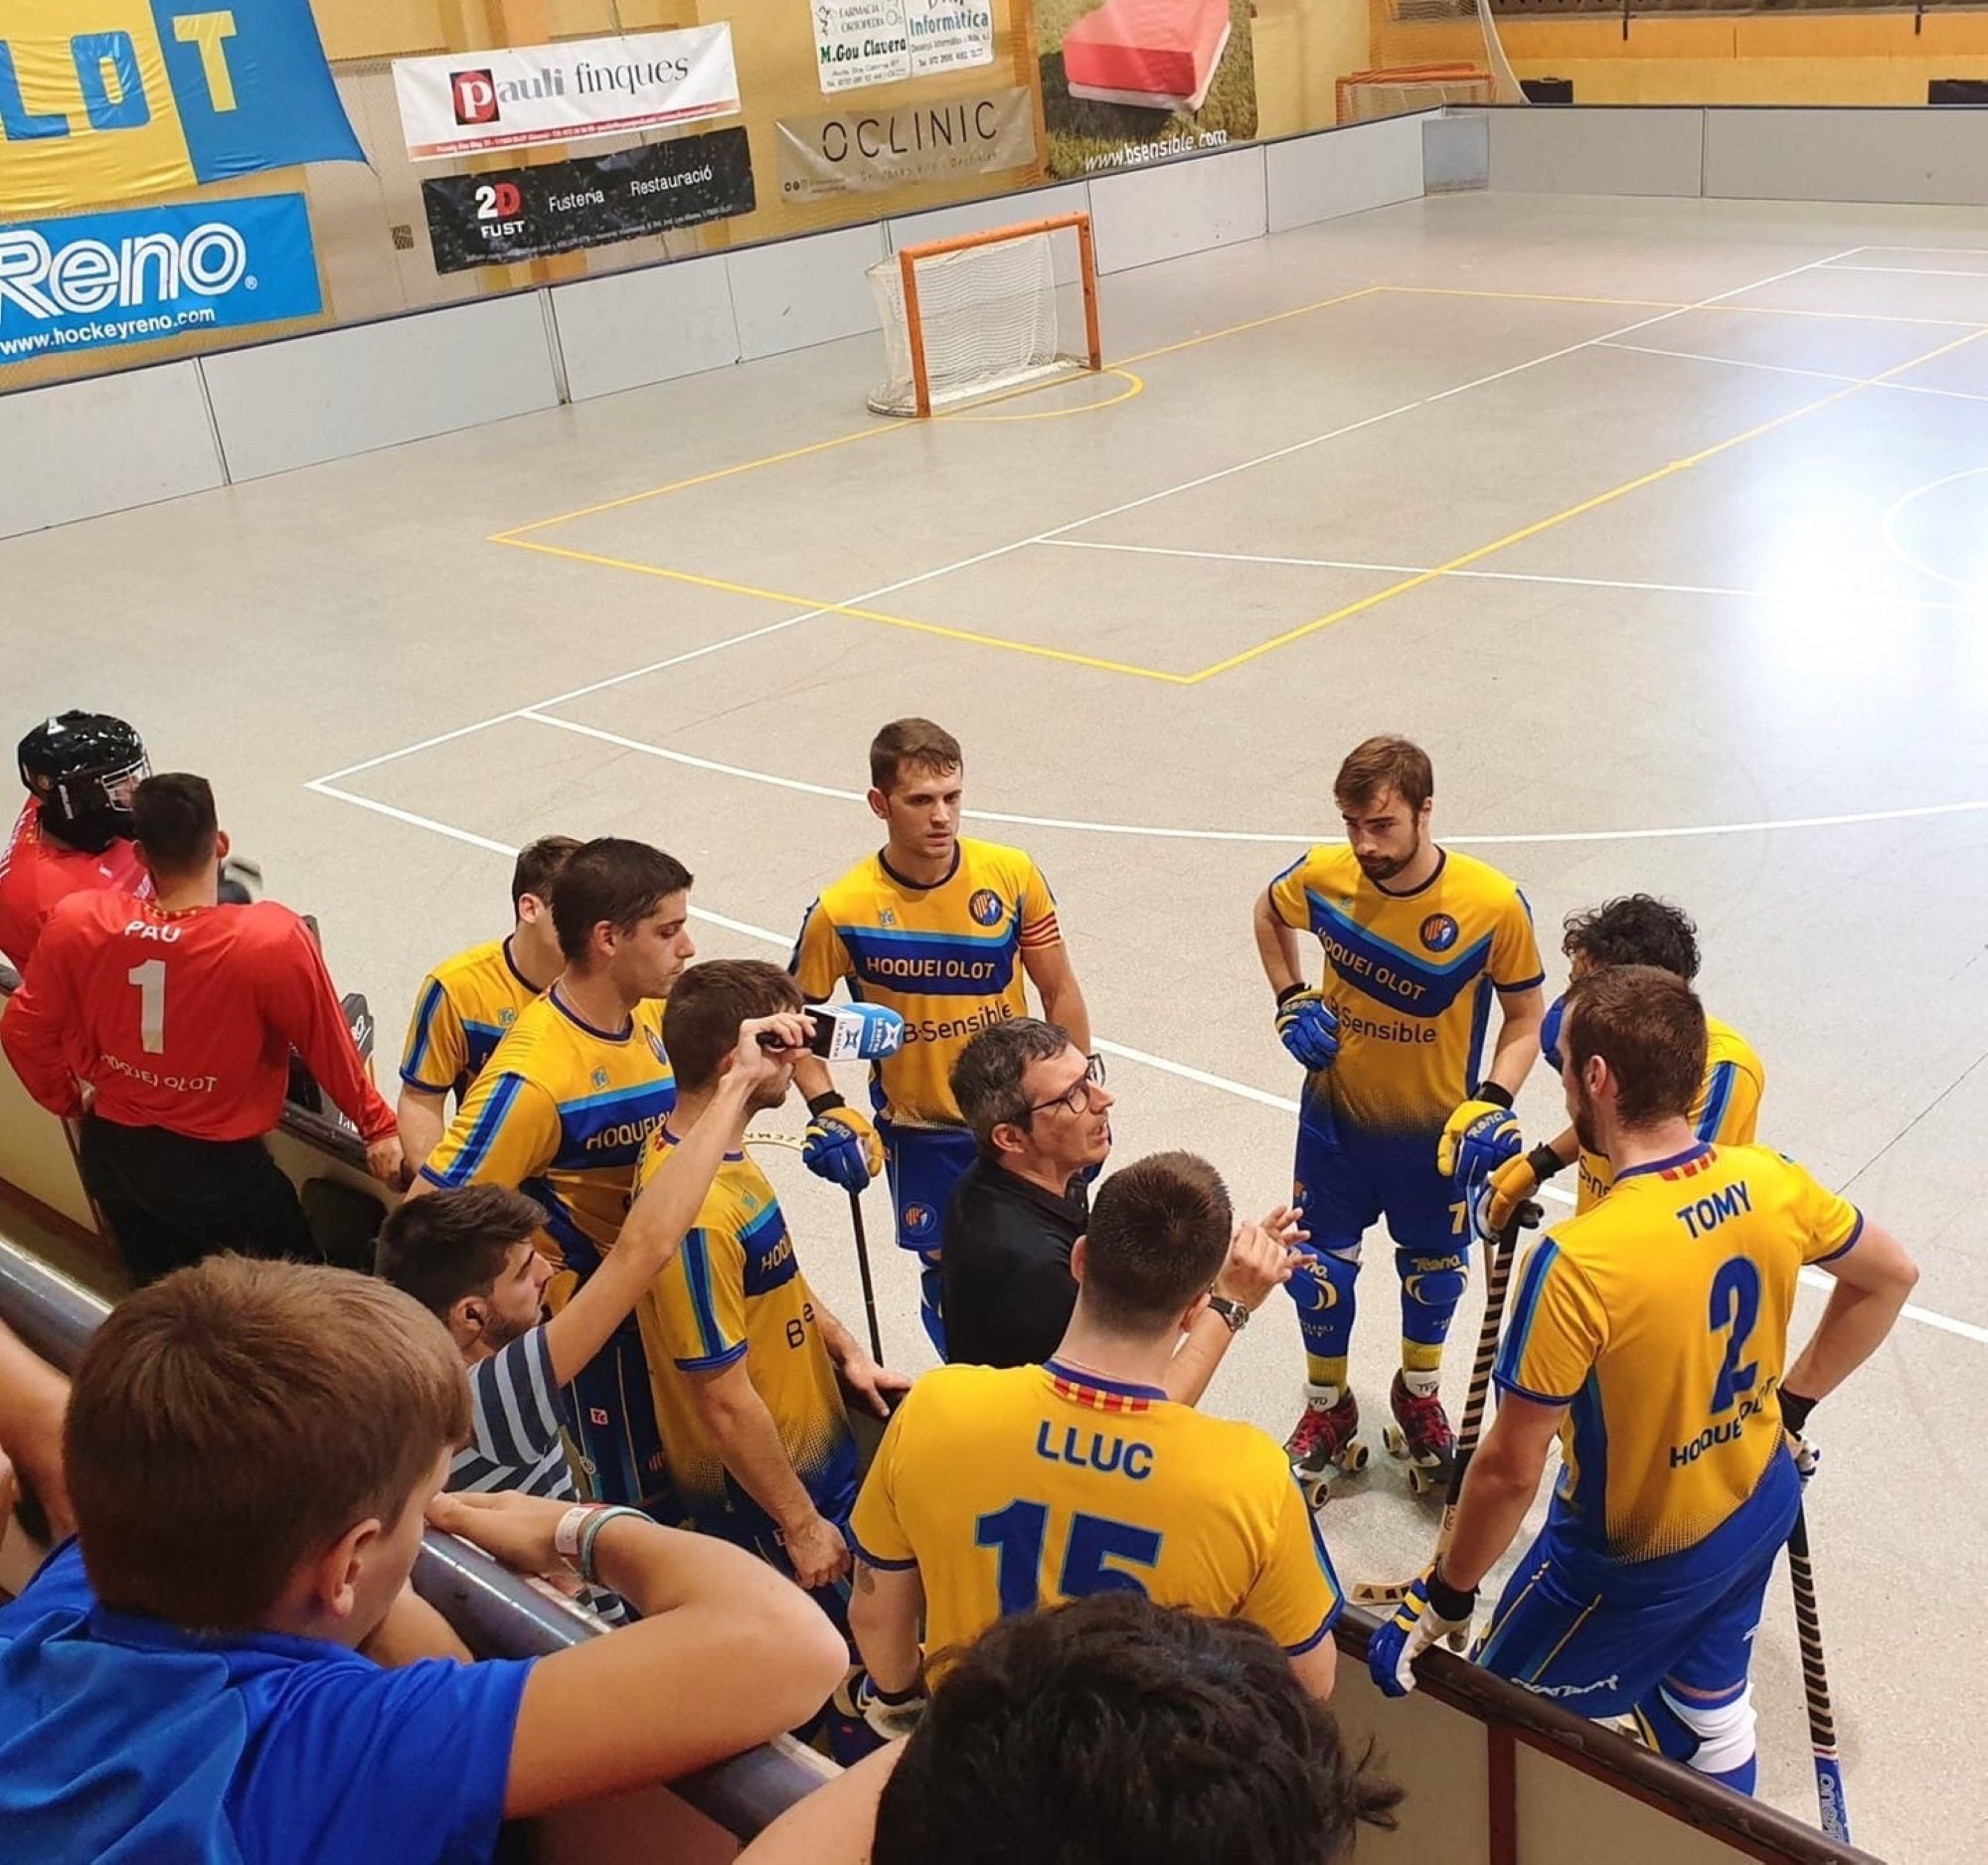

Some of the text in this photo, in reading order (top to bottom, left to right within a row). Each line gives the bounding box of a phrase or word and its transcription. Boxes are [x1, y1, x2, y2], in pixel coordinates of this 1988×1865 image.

[864, 38, 907, 58] Clavera
[576, 56, 690, 94] finques
[822, 101, 997, 162] OCLINIC
[1085, 129, 1229, 172] www.bsensible.com
[475, 182, 523, 220] 2D
[549, 165, 713, 213] Fusteria Restauració
[481, 221, 525, 240] FUST
[1, 305, 216, 355] www.hockeyreno.com
[124, 920, 184, 943] PAU
[866, 956, 995, 980] HOQUEI OLOT
[1375, 966, 1427, 1001] OLOT
[127, 958, 167, 1055] 1
[164, 1076, 218, 1093] OLOT
[1448, 1200, 1467, 1235] 7
[1677, 1180, 1753, 1240] TOMY
[1708, 1256, 1762, 1416] 2
[1036, 1421, 1154, 1480] LLUC
